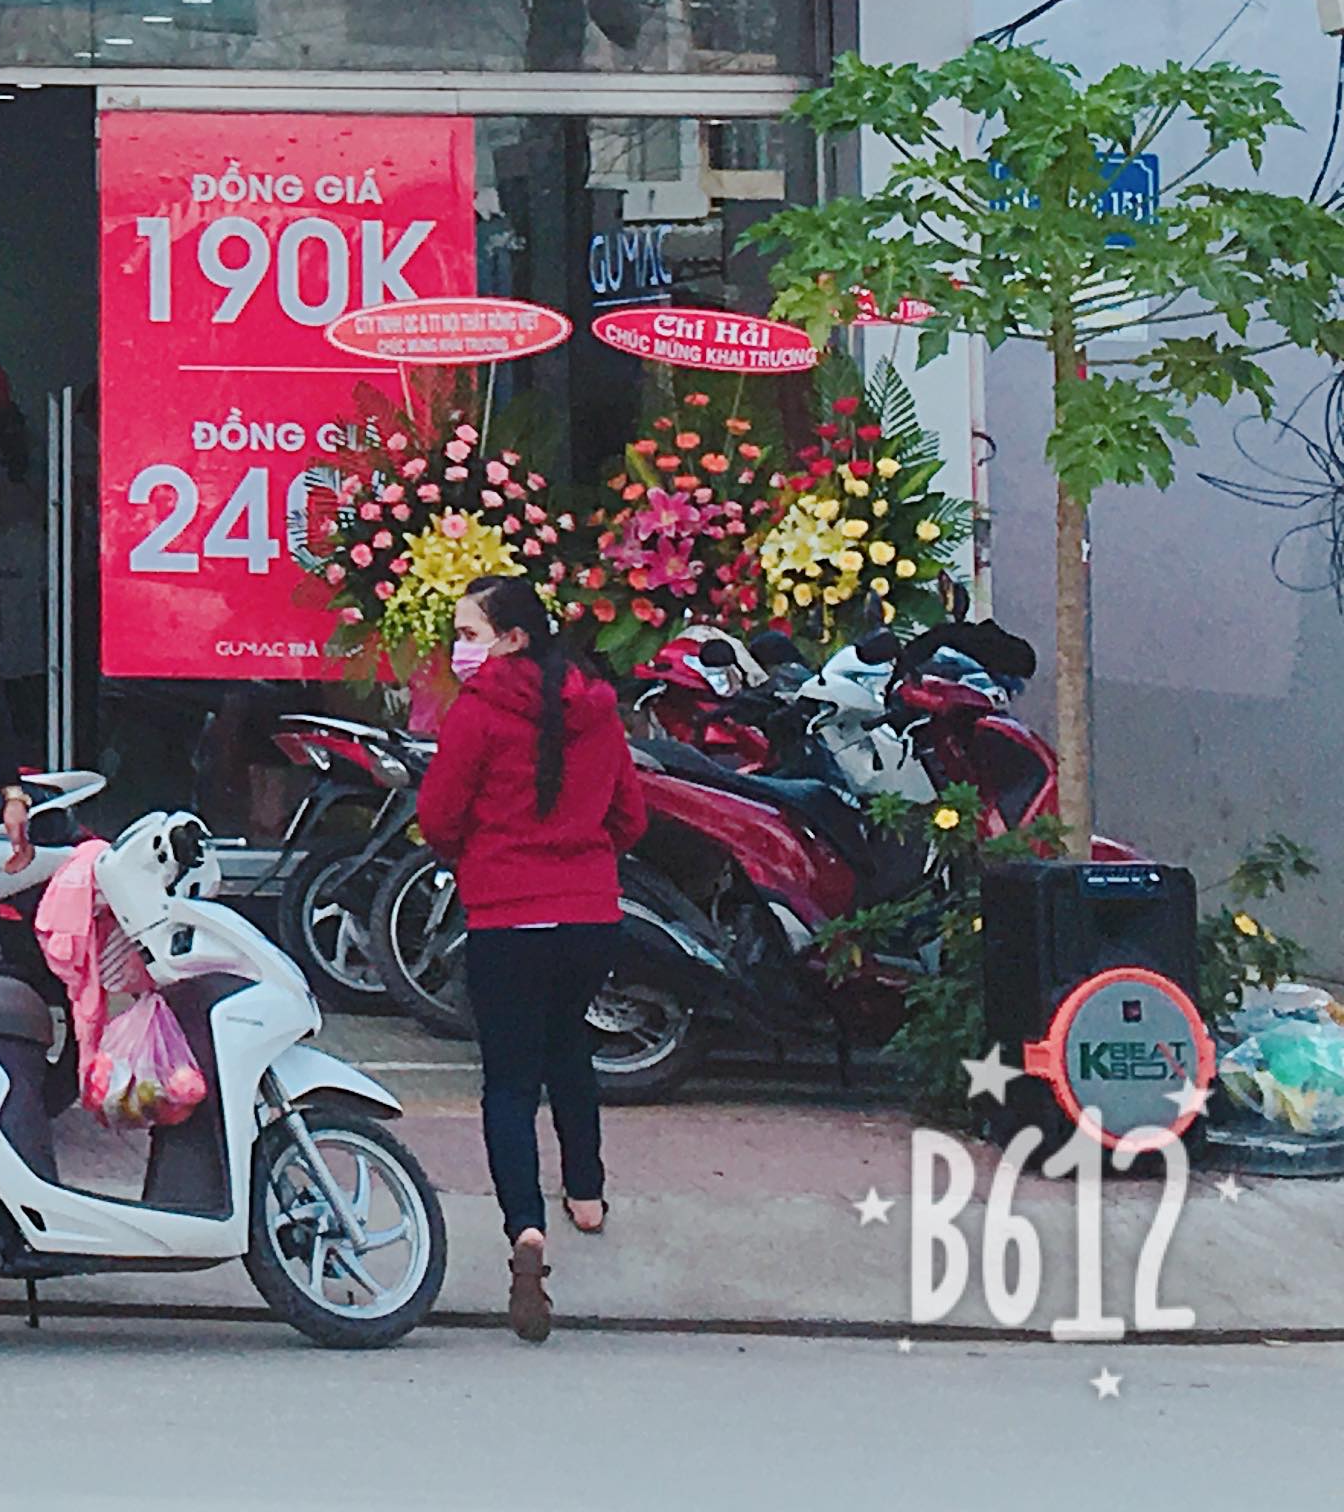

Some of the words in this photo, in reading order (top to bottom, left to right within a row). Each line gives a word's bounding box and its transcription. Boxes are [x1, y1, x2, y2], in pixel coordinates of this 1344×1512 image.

[192, 160, 304, 204] ĐỒNG
[313, 169, 383, 205] GIÁ
[136, 215, 438, 326] 190K
[589, 224, 673, 294] GUMAC
[604, 323, 651, 353] CHÚC
[706, 347, 745, 367] KHAI
[192, 406, 305, 452] ĐỒNG
[215, 639, 286, 658] GUMAC
